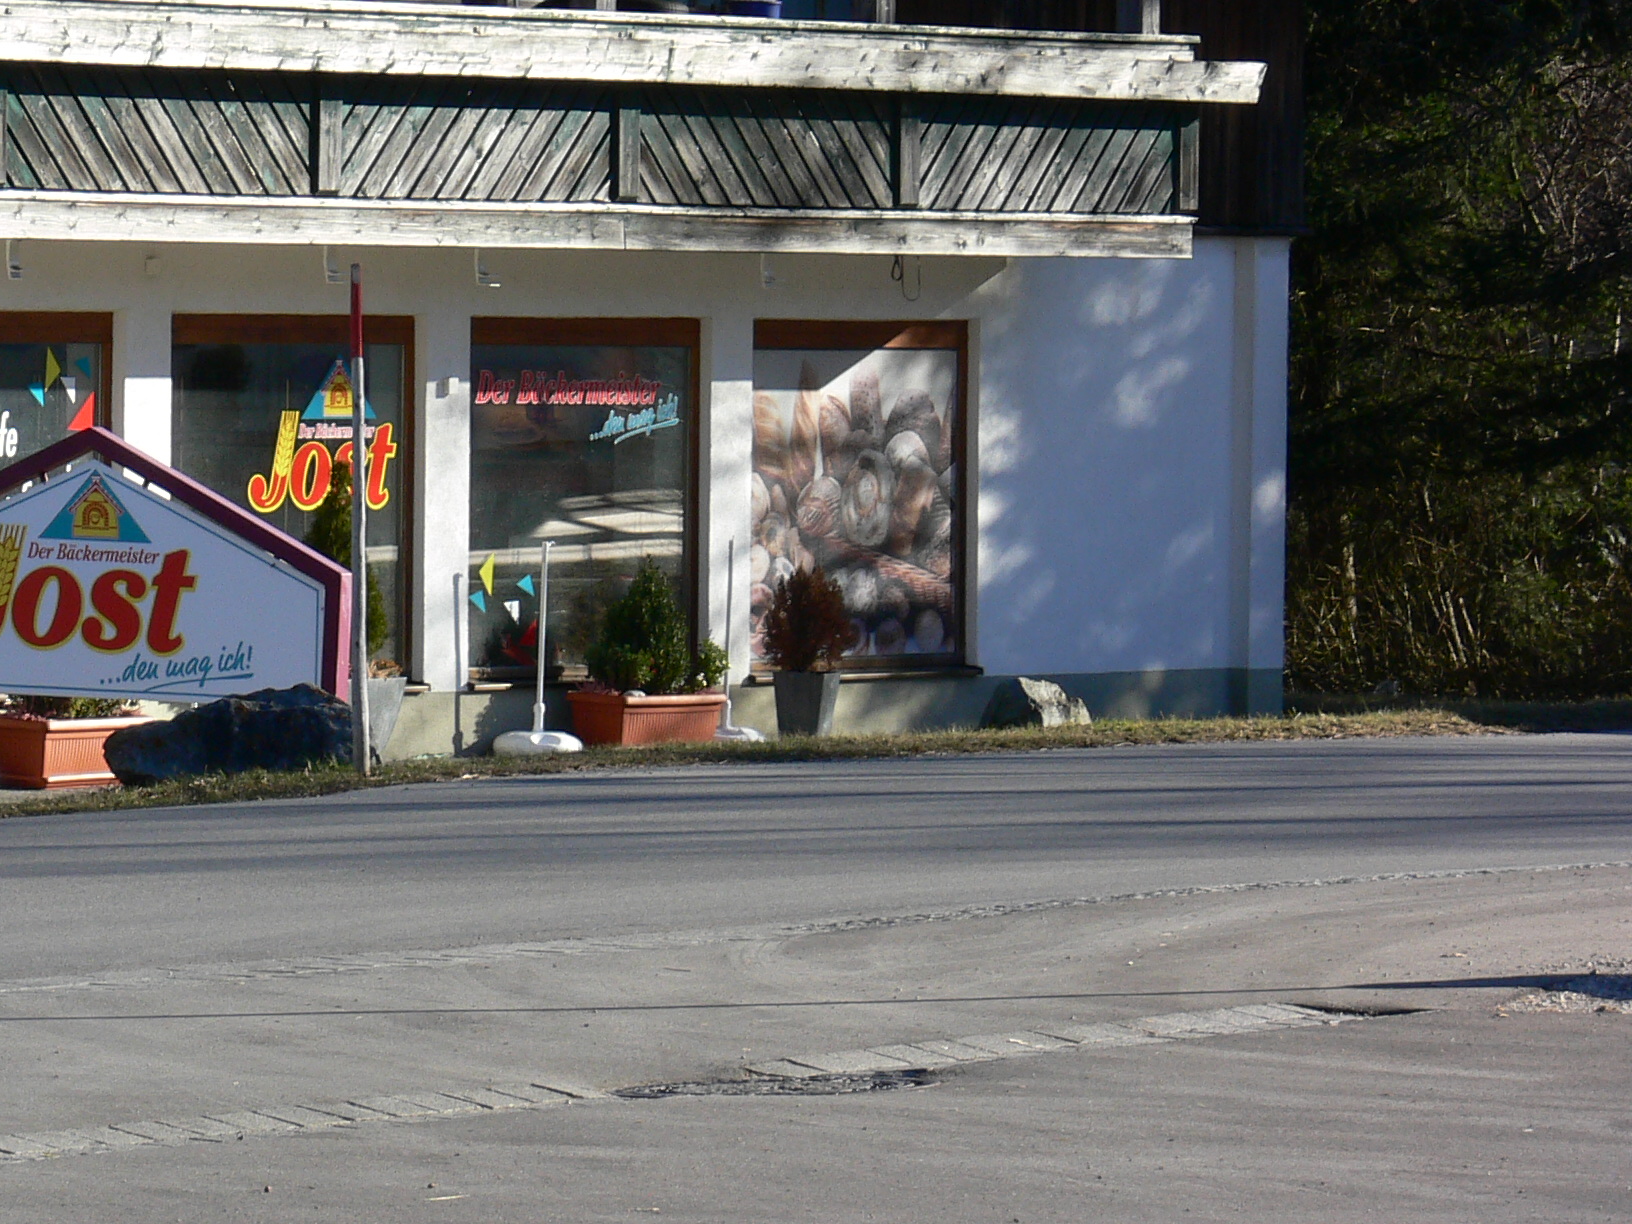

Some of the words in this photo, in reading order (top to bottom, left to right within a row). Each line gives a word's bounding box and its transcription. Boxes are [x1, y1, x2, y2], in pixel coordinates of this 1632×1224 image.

[475, 369, 515, 405] Der
[515, 369, 662, 406] Bäckermeister
[27, 541, 54, 560] Der
[56, 542, 160, 564] Bäckermeister
[165, 655, 213, 687] mag
[218, 640, 253, 673] ich!
